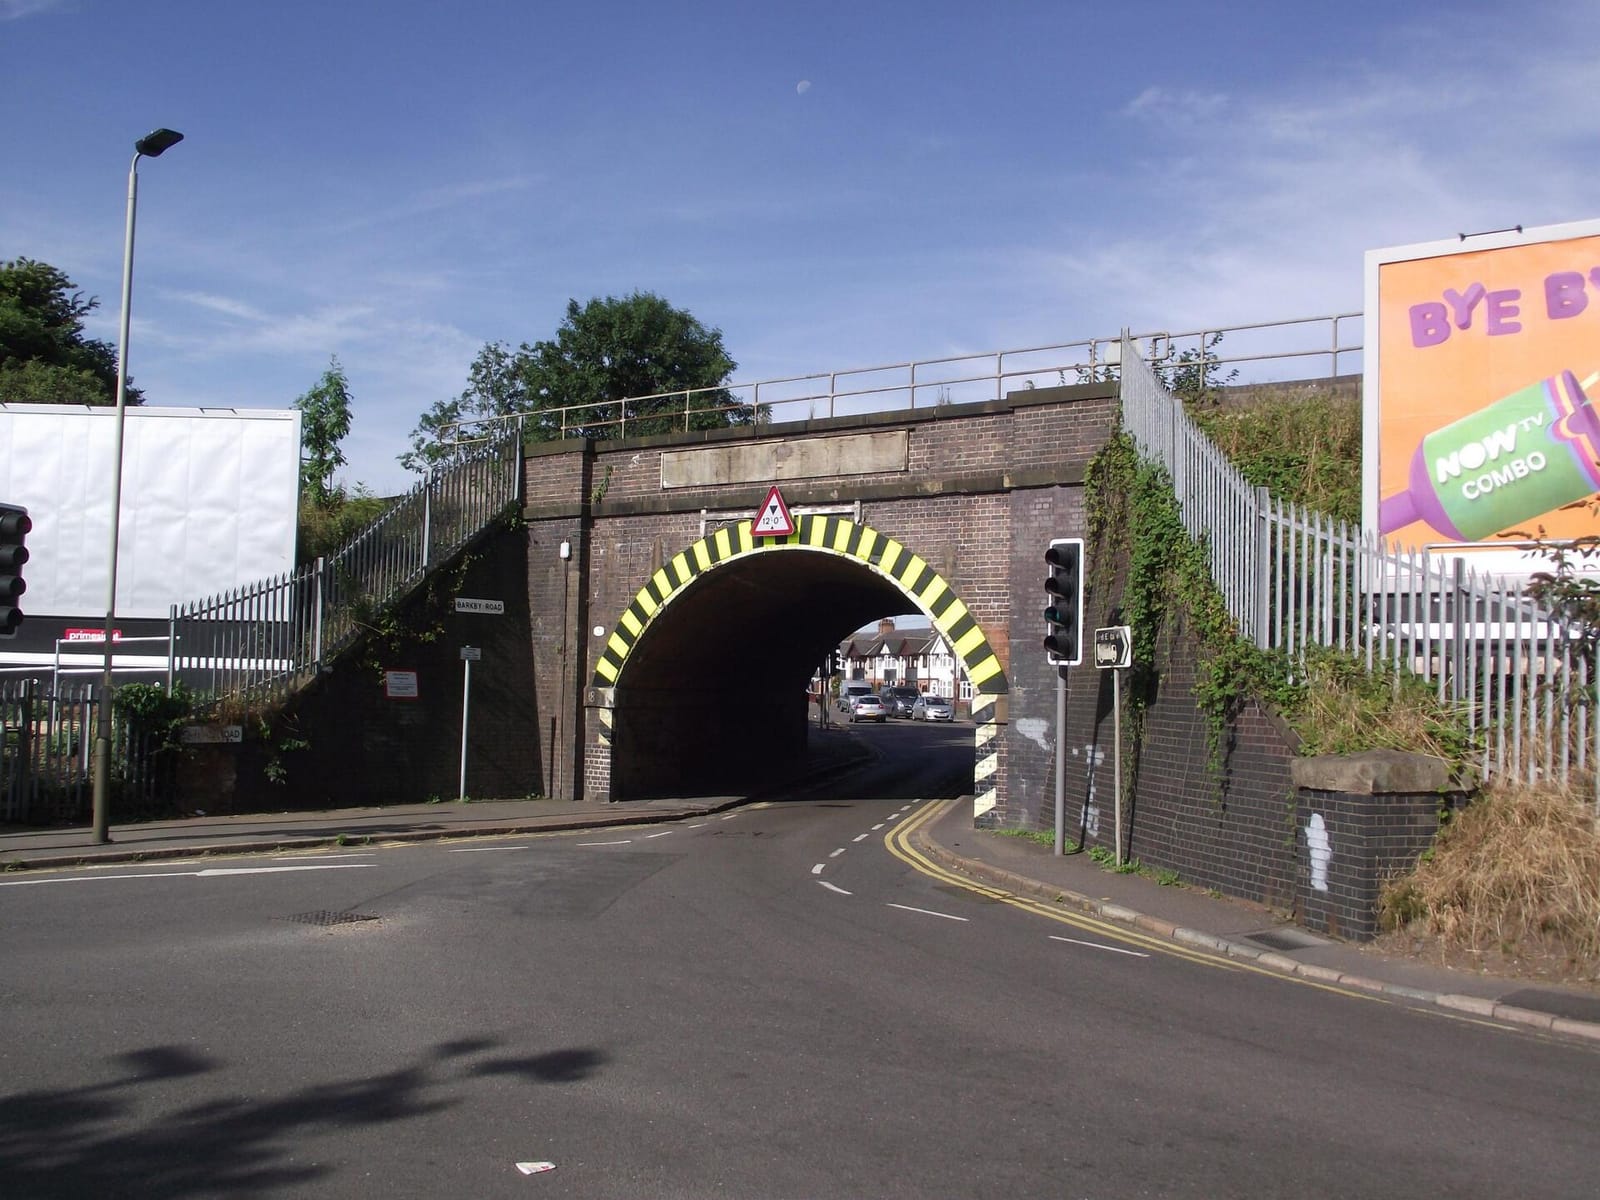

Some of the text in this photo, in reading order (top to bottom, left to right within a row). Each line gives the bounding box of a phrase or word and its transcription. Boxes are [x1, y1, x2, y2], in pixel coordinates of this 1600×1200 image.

[1409, 266, 1600, 348] BYE B
[1435, 412, 1544, 484] NOW TV
[1461, 451, 1546, 501] COMBO
[457, 601, 502, 611] BARKBY ROAD
